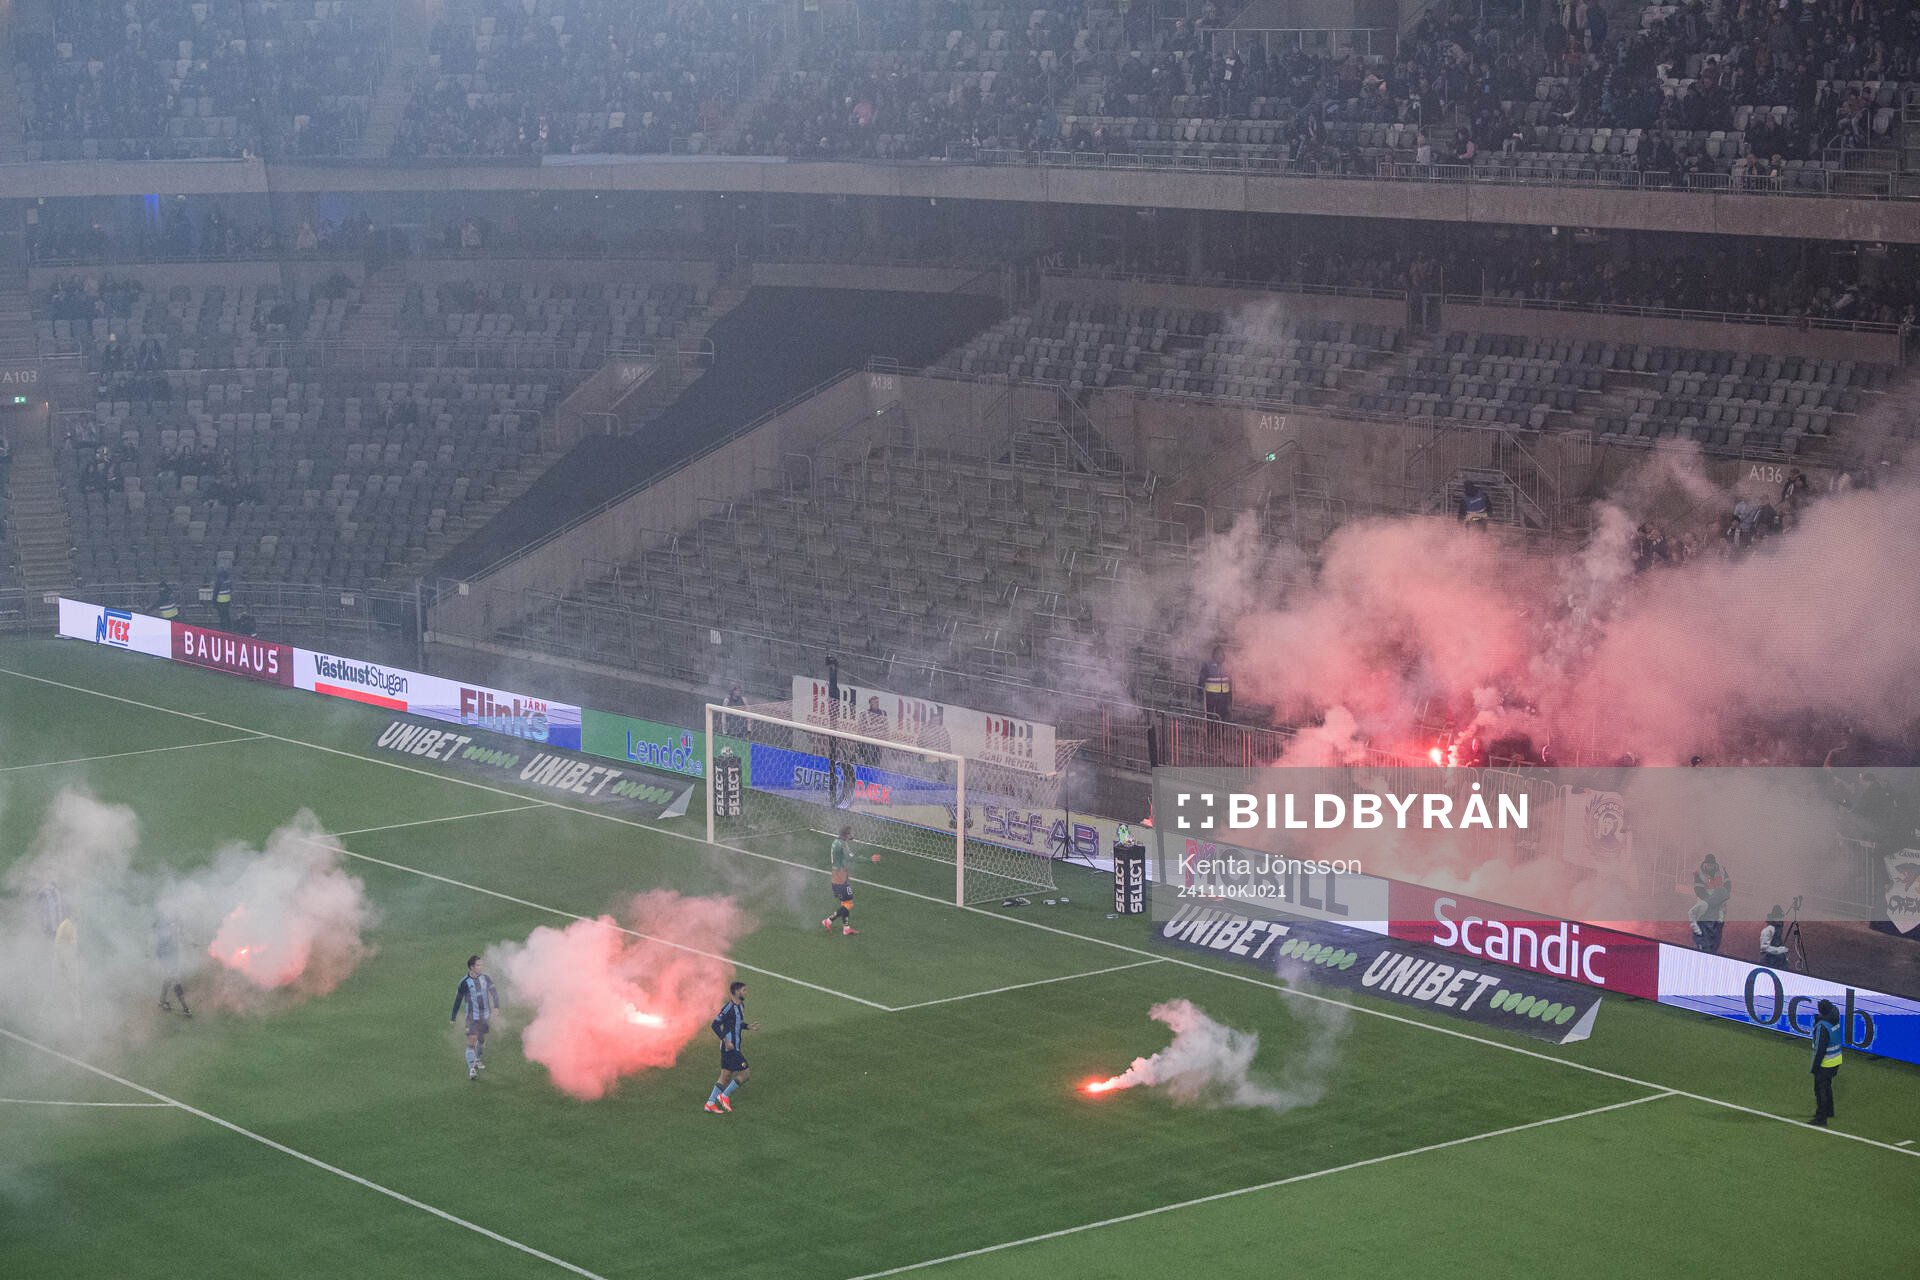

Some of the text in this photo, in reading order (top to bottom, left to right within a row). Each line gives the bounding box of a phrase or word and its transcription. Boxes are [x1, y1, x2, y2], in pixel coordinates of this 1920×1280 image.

[2, 371, 37, 384] A103
[1260, 415, 1286, 430] A137
[1750, 464, 1782, 483] A136
[184, 631, 278, 674] BAUHAUS
[314, 654, 408, 696] VästkustStugan
[461, 687, 548, 741] Flinks
[377, 721, 472, 762] UNIBET
[520, 753, 623, 796] UNIBET
[715, 766, 725, 816] SELECT
[728, 767, 740, 816] SELECT
[794, 767, 831, 790] SUPE
[1115, 857, 1125, 913] SELECT
[1130, 858, 1143, 913] SELECT
[1162, 902, 1290, 960] UNIBET
[1433, 897, 1607, 985] Scandic
[1361, 950, 1501, 1012] UNIBET
[1744, 967, 1874, 1049] Ocb
